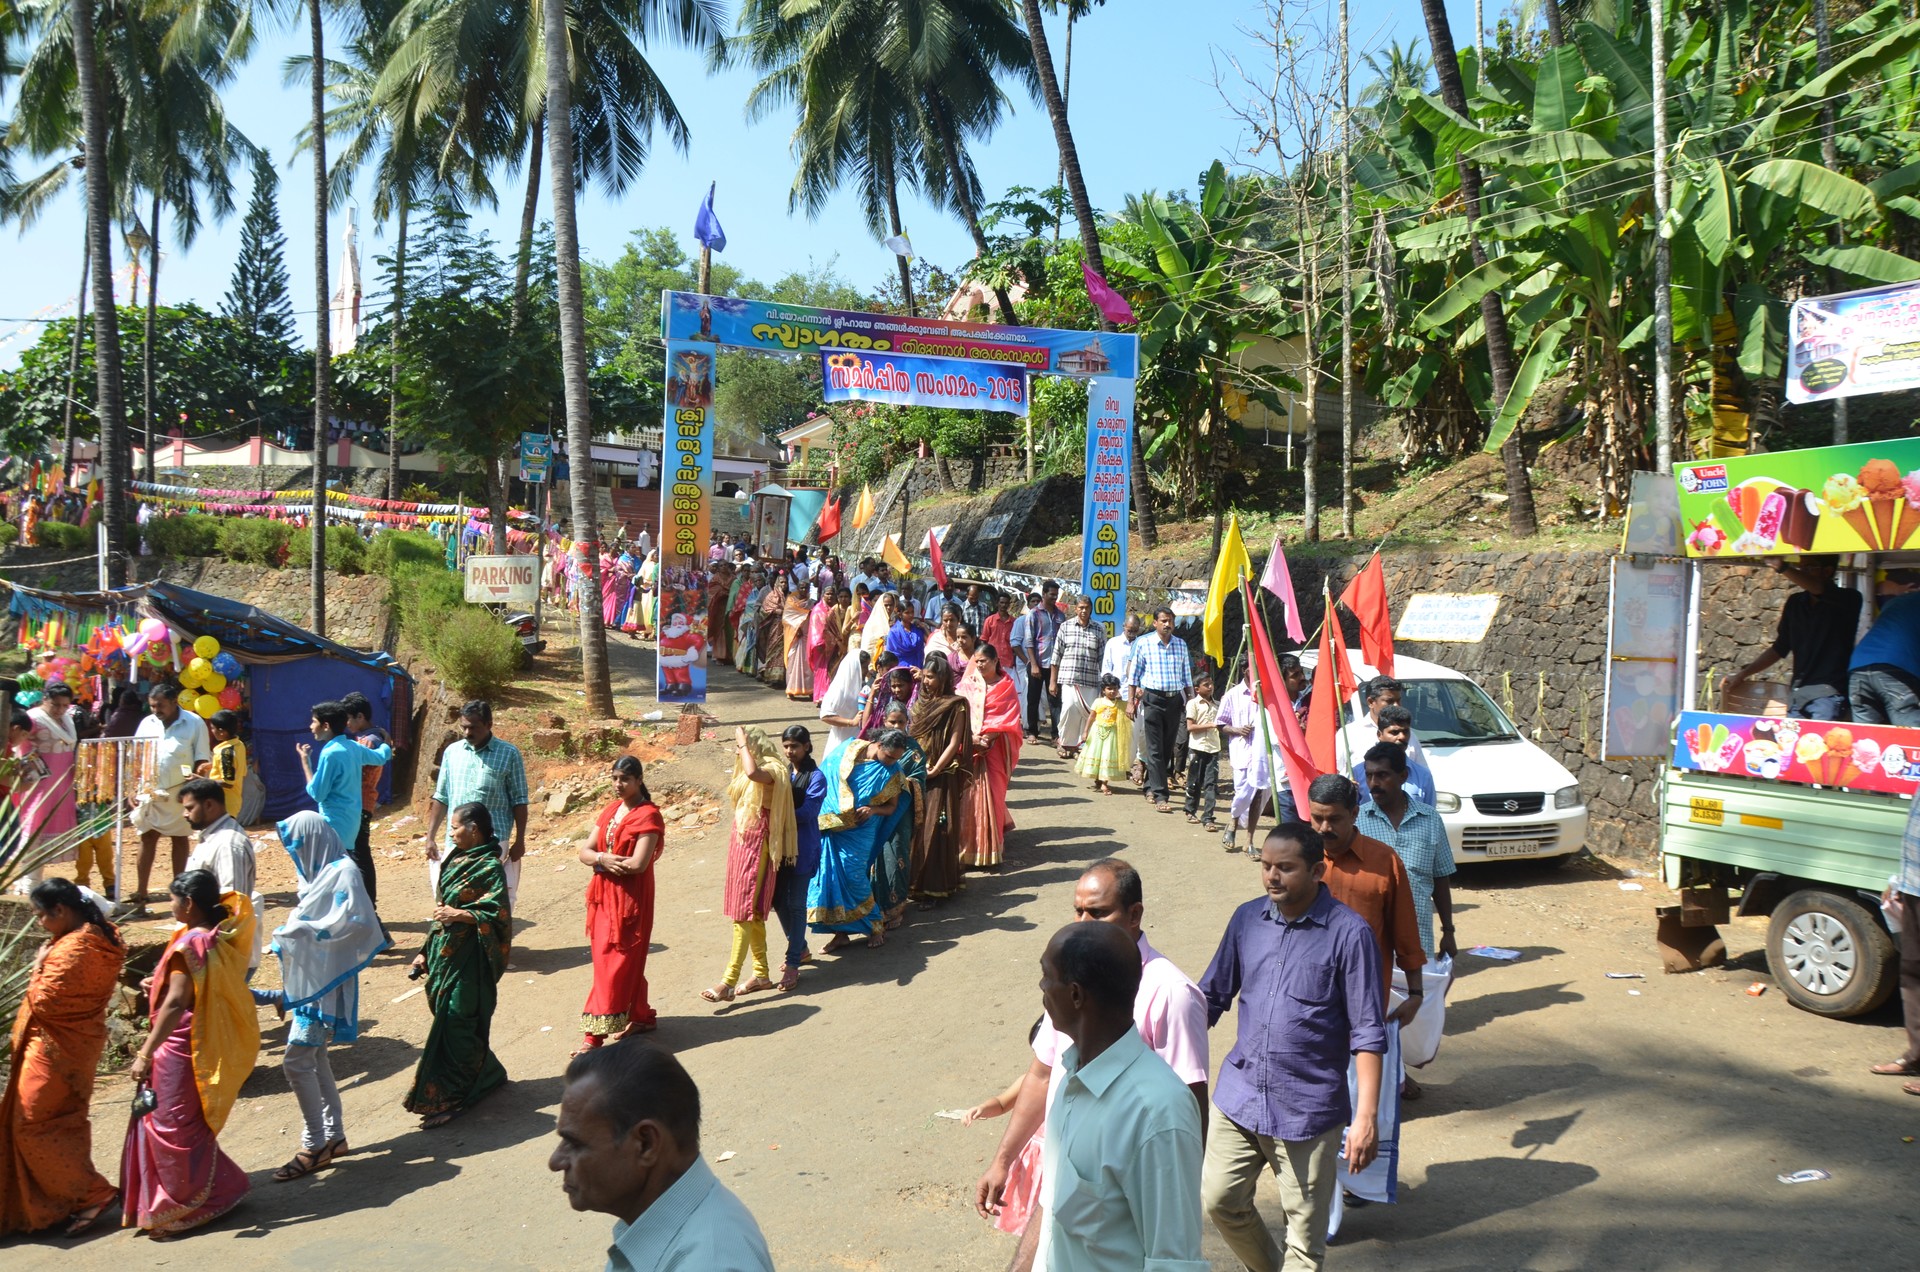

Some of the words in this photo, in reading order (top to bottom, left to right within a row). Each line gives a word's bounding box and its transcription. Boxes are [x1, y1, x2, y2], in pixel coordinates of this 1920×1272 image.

[751, 323, 891, 349] സ്വാഗതം
[969, 347, 1044, 364] ആശംസകൾ
[830, 359, 911, 393] സമർപ്പിത
[1104, 396, 1120, 415] ദിവ്യ
[1096, 417, 1127, 433] കാരുണ്യ
[1700, 468, 1725, 477] Uncle
[1702, 479, 1727, 489] JOHN
[1096, 509, 1119, 521] കരണ
[472, 566, 532, 585] PARKING
